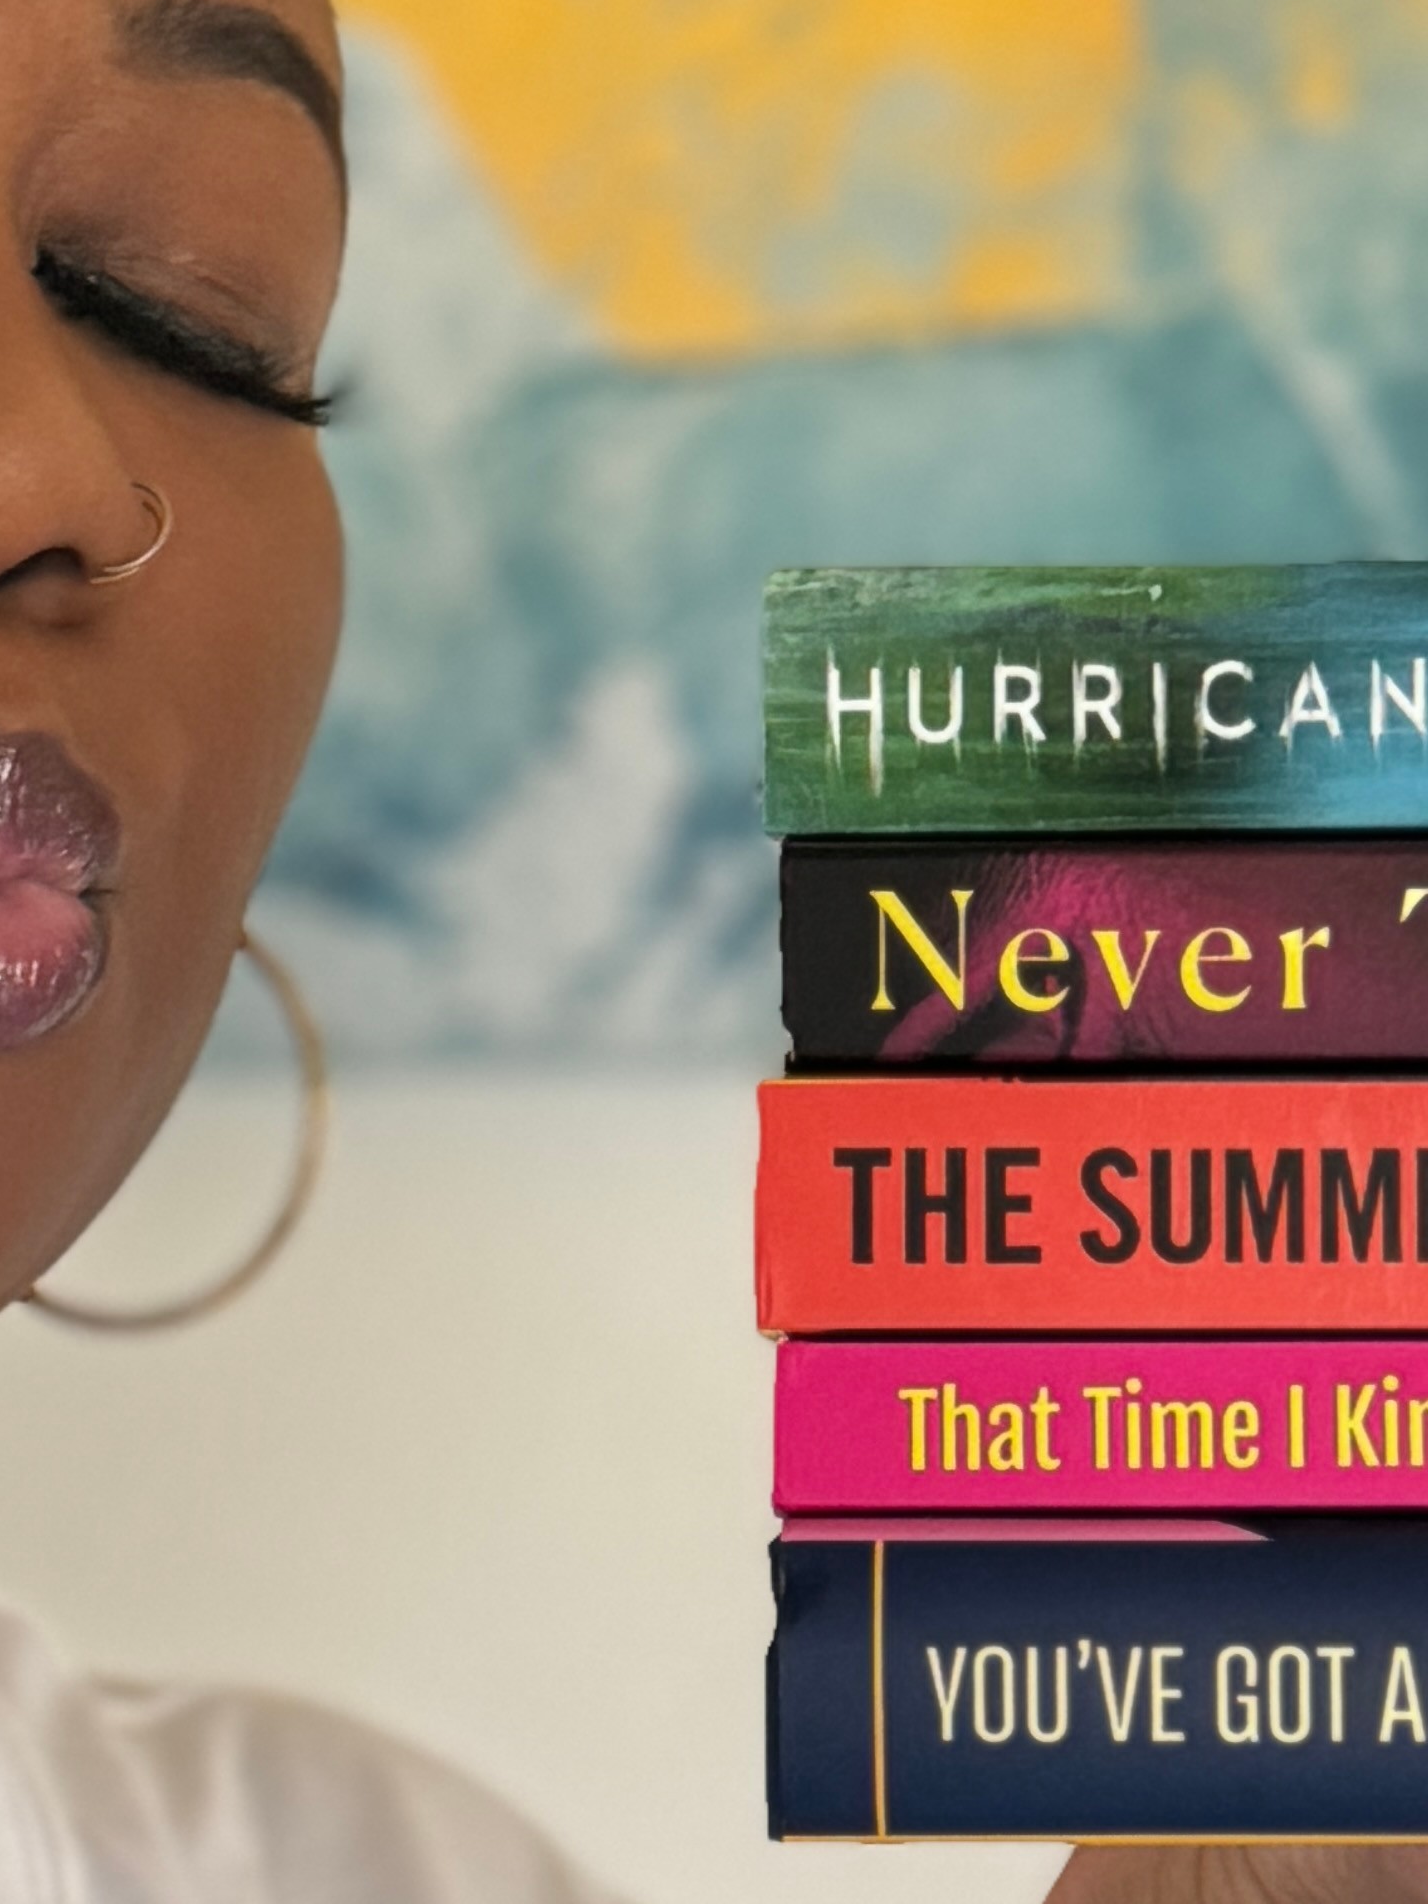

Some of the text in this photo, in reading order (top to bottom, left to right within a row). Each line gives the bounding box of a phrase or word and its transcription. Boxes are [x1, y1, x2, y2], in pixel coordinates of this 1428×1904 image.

[869, 890, 1330, 1012] Never
[833, 1146, 1043, 1265] THE
[899, 1383, 1061, 1473] That
[1083, 1378, 1259, 1471] Time
[1289, 1385, 1305, 1468] I
[927, 1639, 1185, 1744] YOU'VE
[1217, 1648, 1355, 1744] GOT
[1379, 1647, 1427, 1744] A
